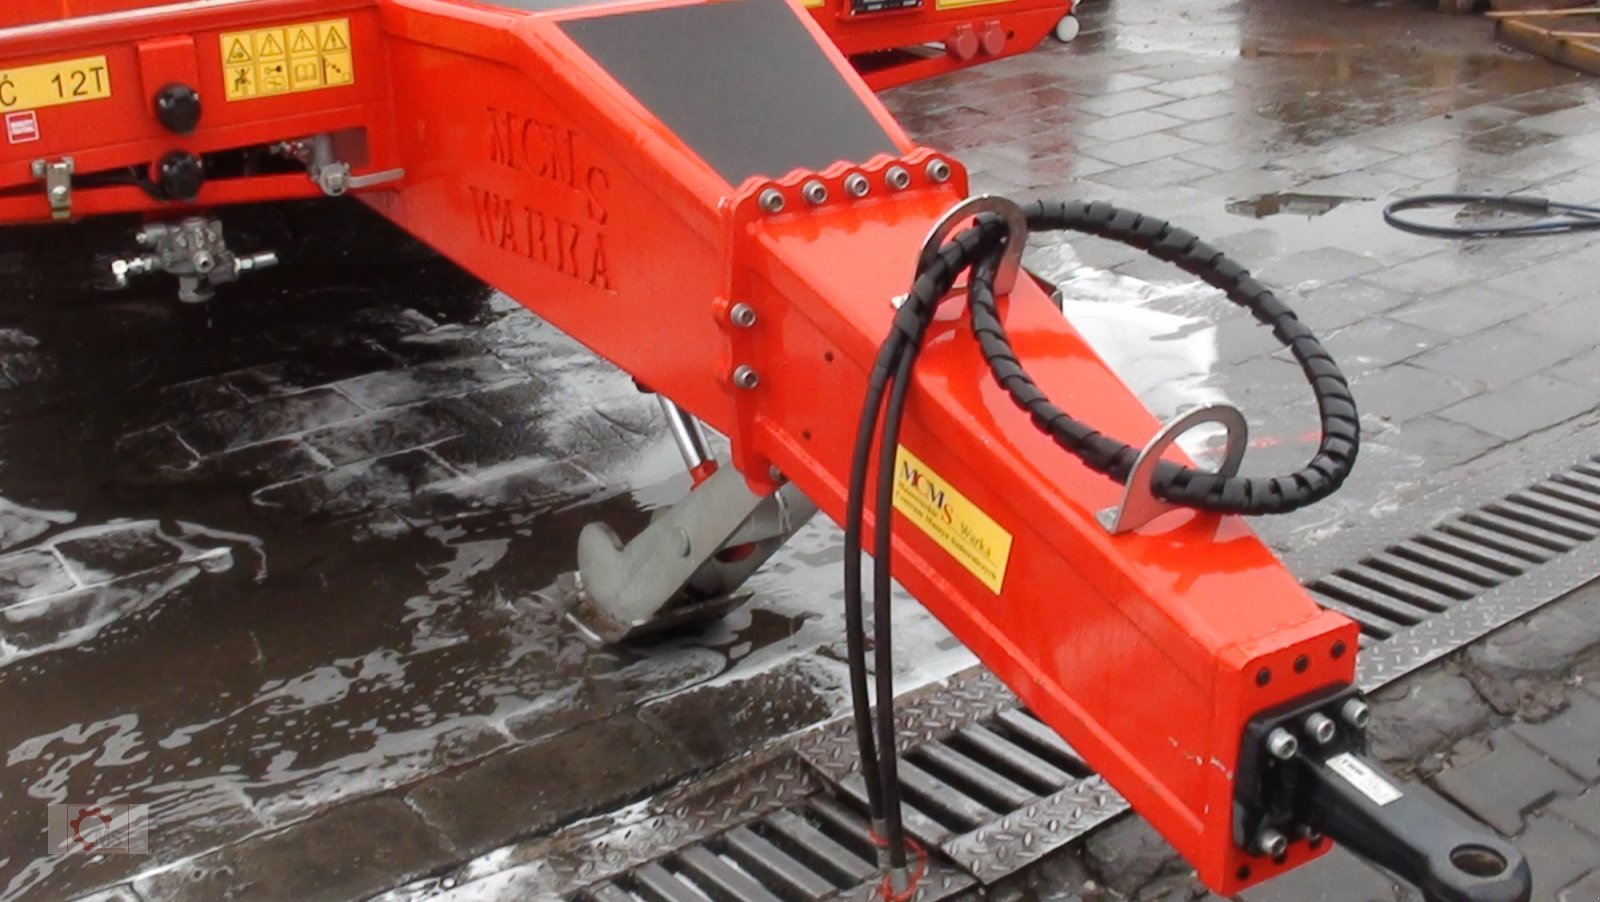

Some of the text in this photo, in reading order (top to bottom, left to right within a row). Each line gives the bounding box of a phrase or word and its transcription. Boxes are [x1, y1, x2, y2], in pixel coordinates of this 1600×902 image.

[51, 66, 105, 98] 12T
[486, 105, 610, 226] MCMS
[468, 185, 612, 290] WARKA
[901, 460, 953, 525] MCMS
